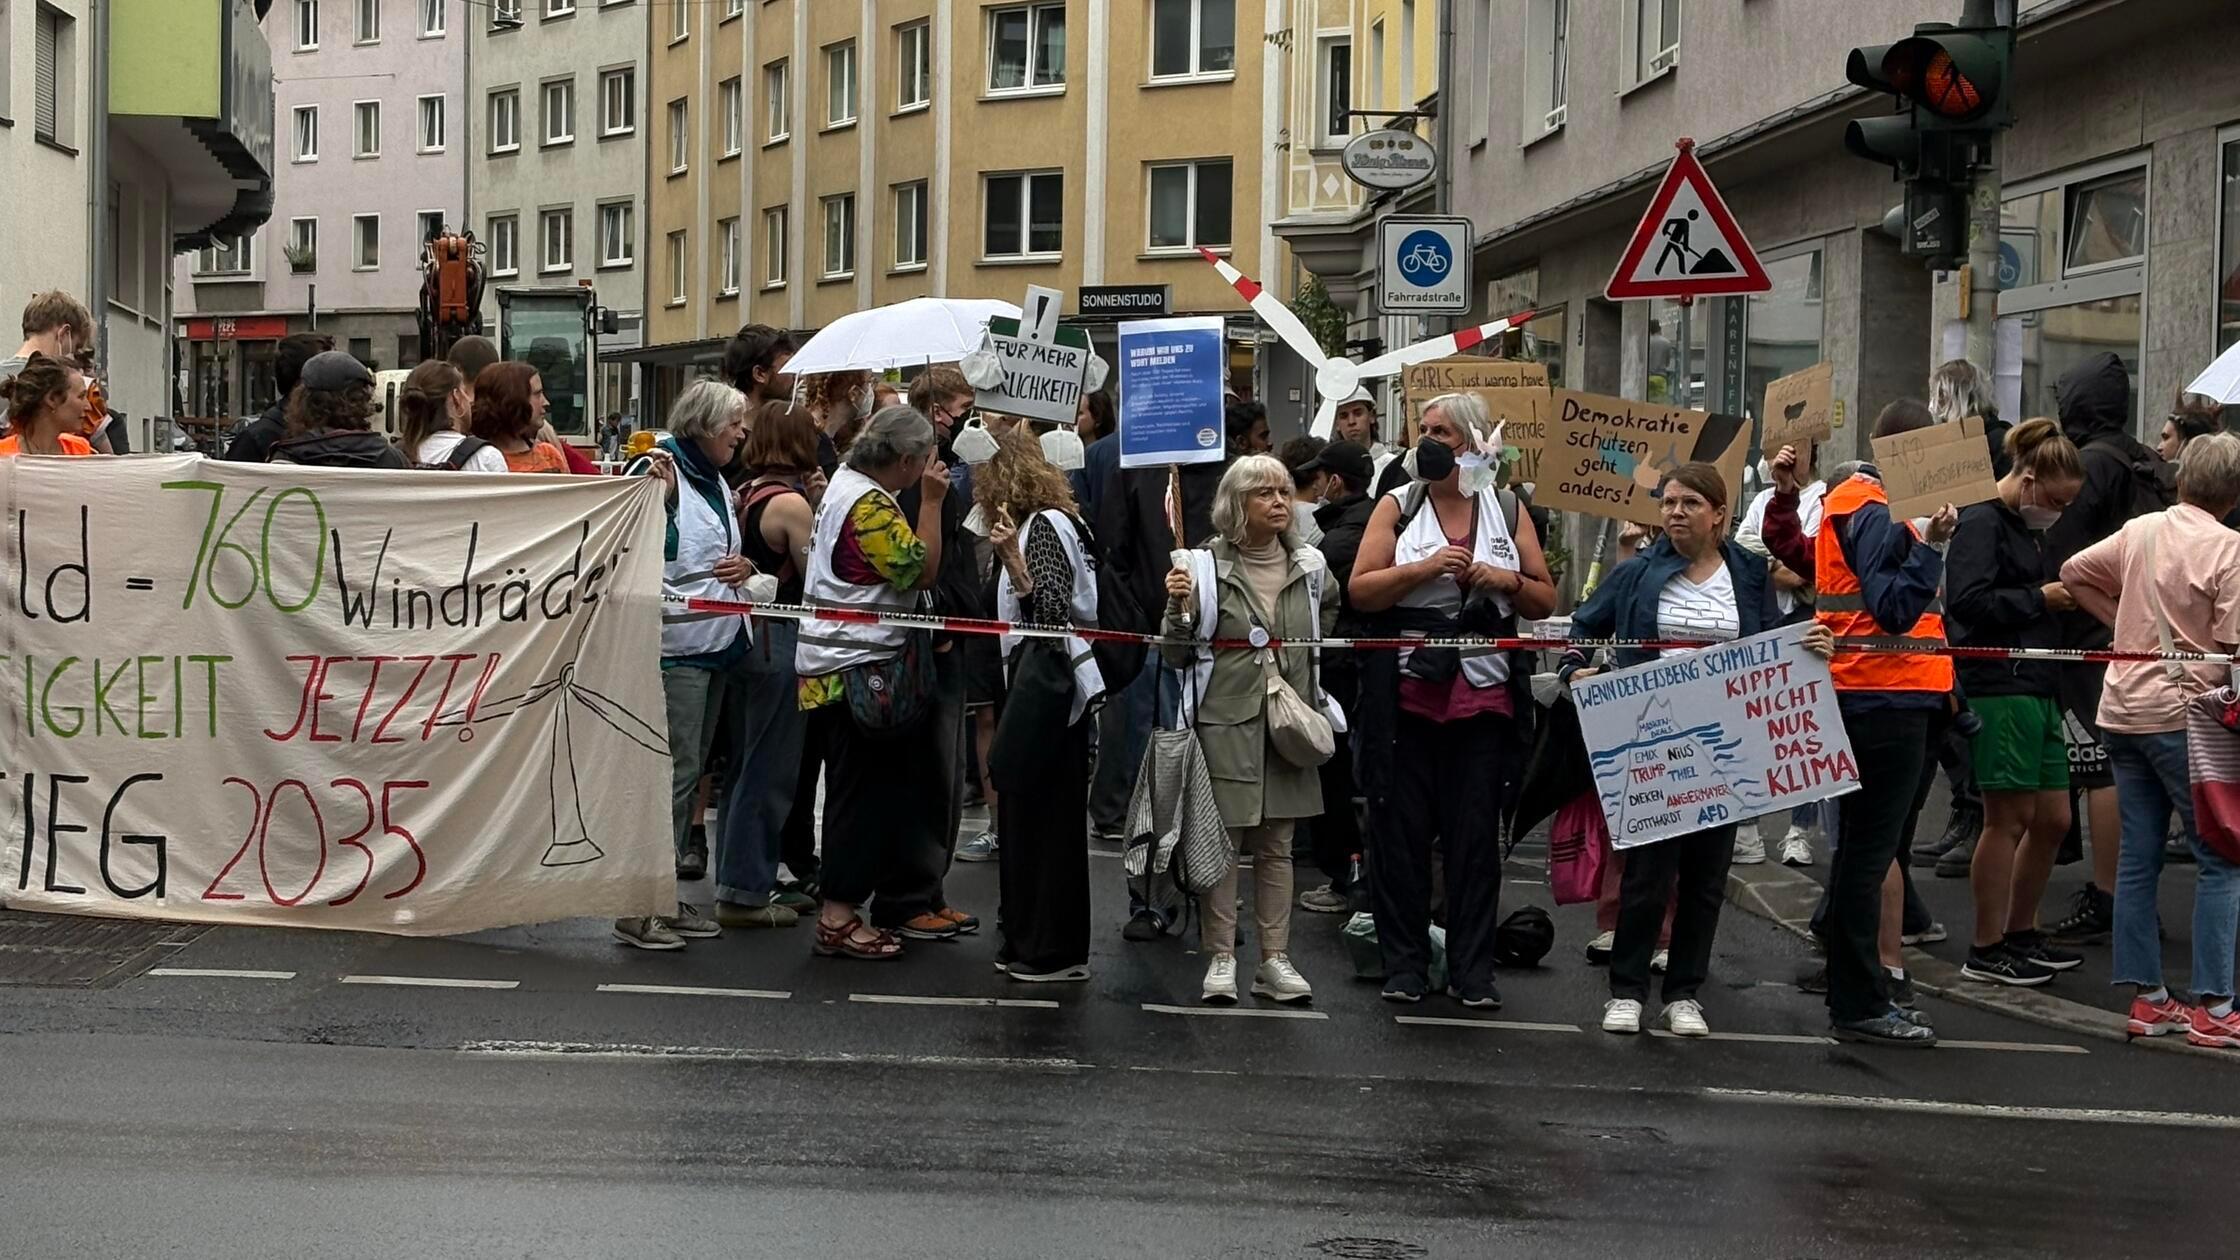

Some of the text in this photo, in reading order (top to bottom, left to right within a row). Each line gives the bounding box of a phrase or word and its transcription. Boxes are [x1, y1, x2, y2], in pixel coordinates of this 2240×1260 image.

[1082, 294, 1162, 308] SONNENSTUDIO
[1387, 291, 1462, 303] Fahrradstraße
[1031, 346, 1078, 368] MEHR
[1149, 356, 1176, 366] MELDEN
[1728, 299, 1738, 415] AARENTFE
[1411, 367, 1545, 390] GIRLS just wanna have
[1561, 398, 1690, 434] Demokratie
[1566, 427, 1648, 454] schützen
[1574, 455, 1617, 476] geht
[1559, 480, 1635, 505] anders!
[18, 505, 90, 623] ld
[161, 481, 327, 612] 760
[1571, 637, 1783, 710] WENN DER EISBERG SCHMILZT
[1725, 661, 1793, 699] KIPPT
[0, 652, 501, 744] IGKEIT JETZT!
[1745, 680, 1822, 719] NICHT
[1767, 709, 1820, 741] NUR
[1634, 749, 1659, 764] EMIX
[1774, 735, 1823, 762] DAS
[2066, 743, 2108, 762] das
[1629, 763, 1699, 784] TRUMP THIEL
[1767, 749, 1858, 798] KLIMA
[2069, 763, 2103, 773] ETICS
[1629, 789, 1664, 807] DIEKEN
[1626, 803, 1729, 834] GOTTHARDT AFD
[18, 773, 429, 907] IEG 2035
